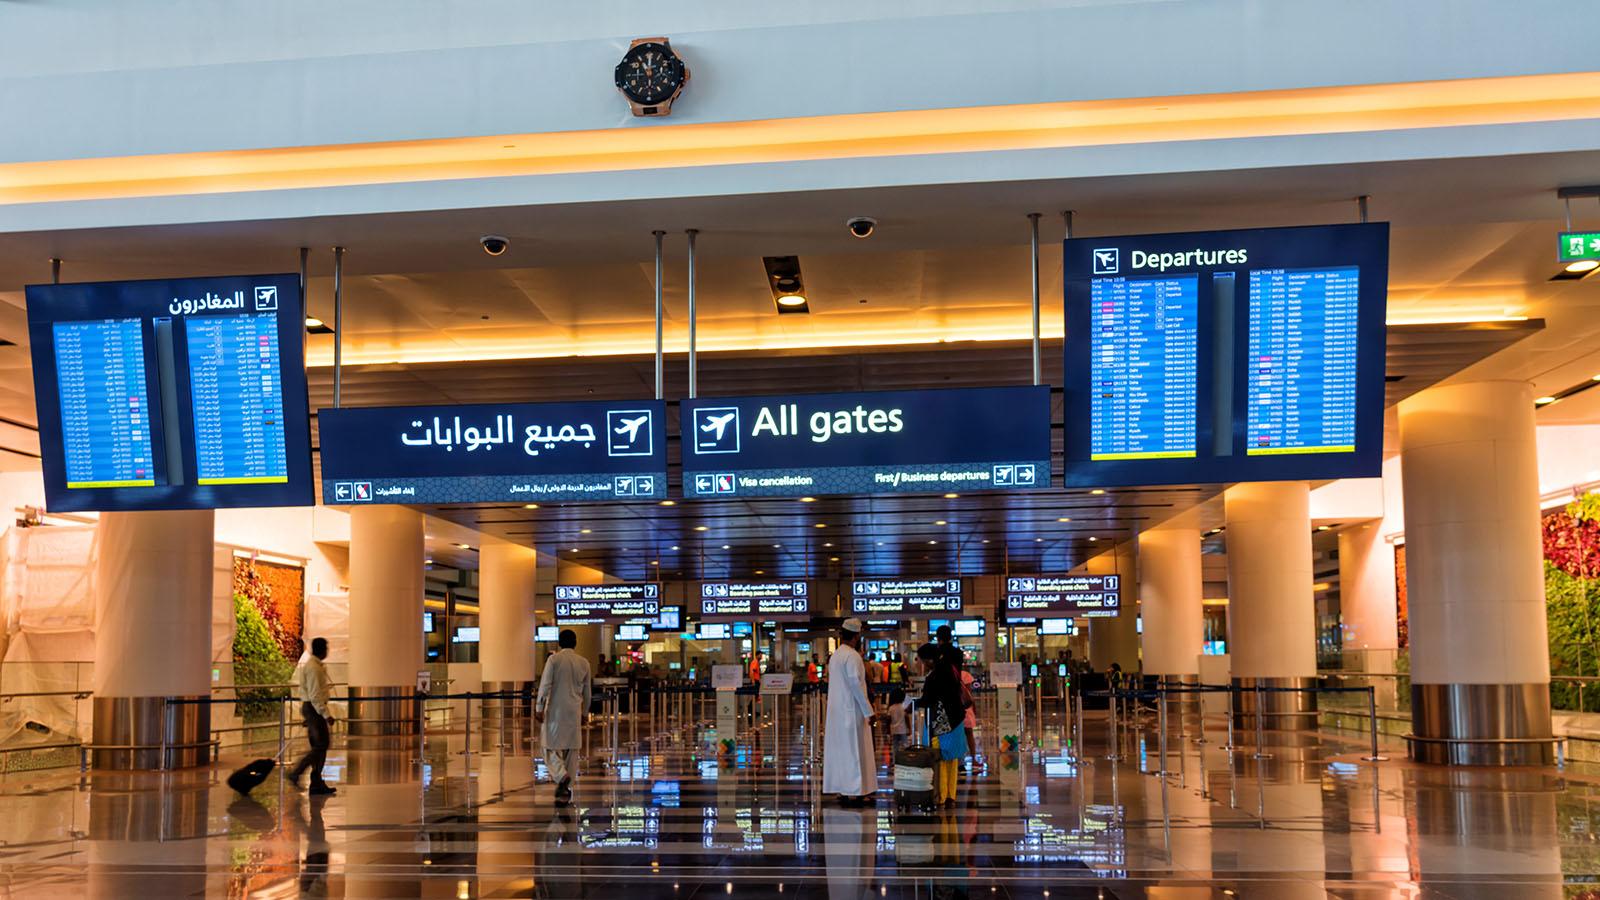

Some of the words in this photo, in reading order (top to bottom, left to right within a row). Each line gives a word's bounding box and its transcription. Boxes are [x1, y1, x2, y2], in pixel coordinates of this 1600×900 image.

[1132, 248, 1248, 272] Departures
[168, 291, 244, 314] المغادرون
[752, 404, 798, 436] All
[810, 405, 904, 442] gates
[401, 414, 514, 452] البوابات
[524, 424, 596, 456] جميع
[940, 470, 990, 482] departures
[738, 477, 758, 487] Visa
[759, 476, 813, 486] cancellation
[584, 483, 612, 492] المغادرون
[950, 582, 957, 591] 3
[1011, 580, 1019, 590] 2
[1108, 578, 1114, 588] 1
[559, 588, 566, 598] 8
[648, 586, 654, 596] 7
[706, 585, 713, 595] 6
[796, 584, 804, 594] 5
[856, 584, 864, 593] 4
